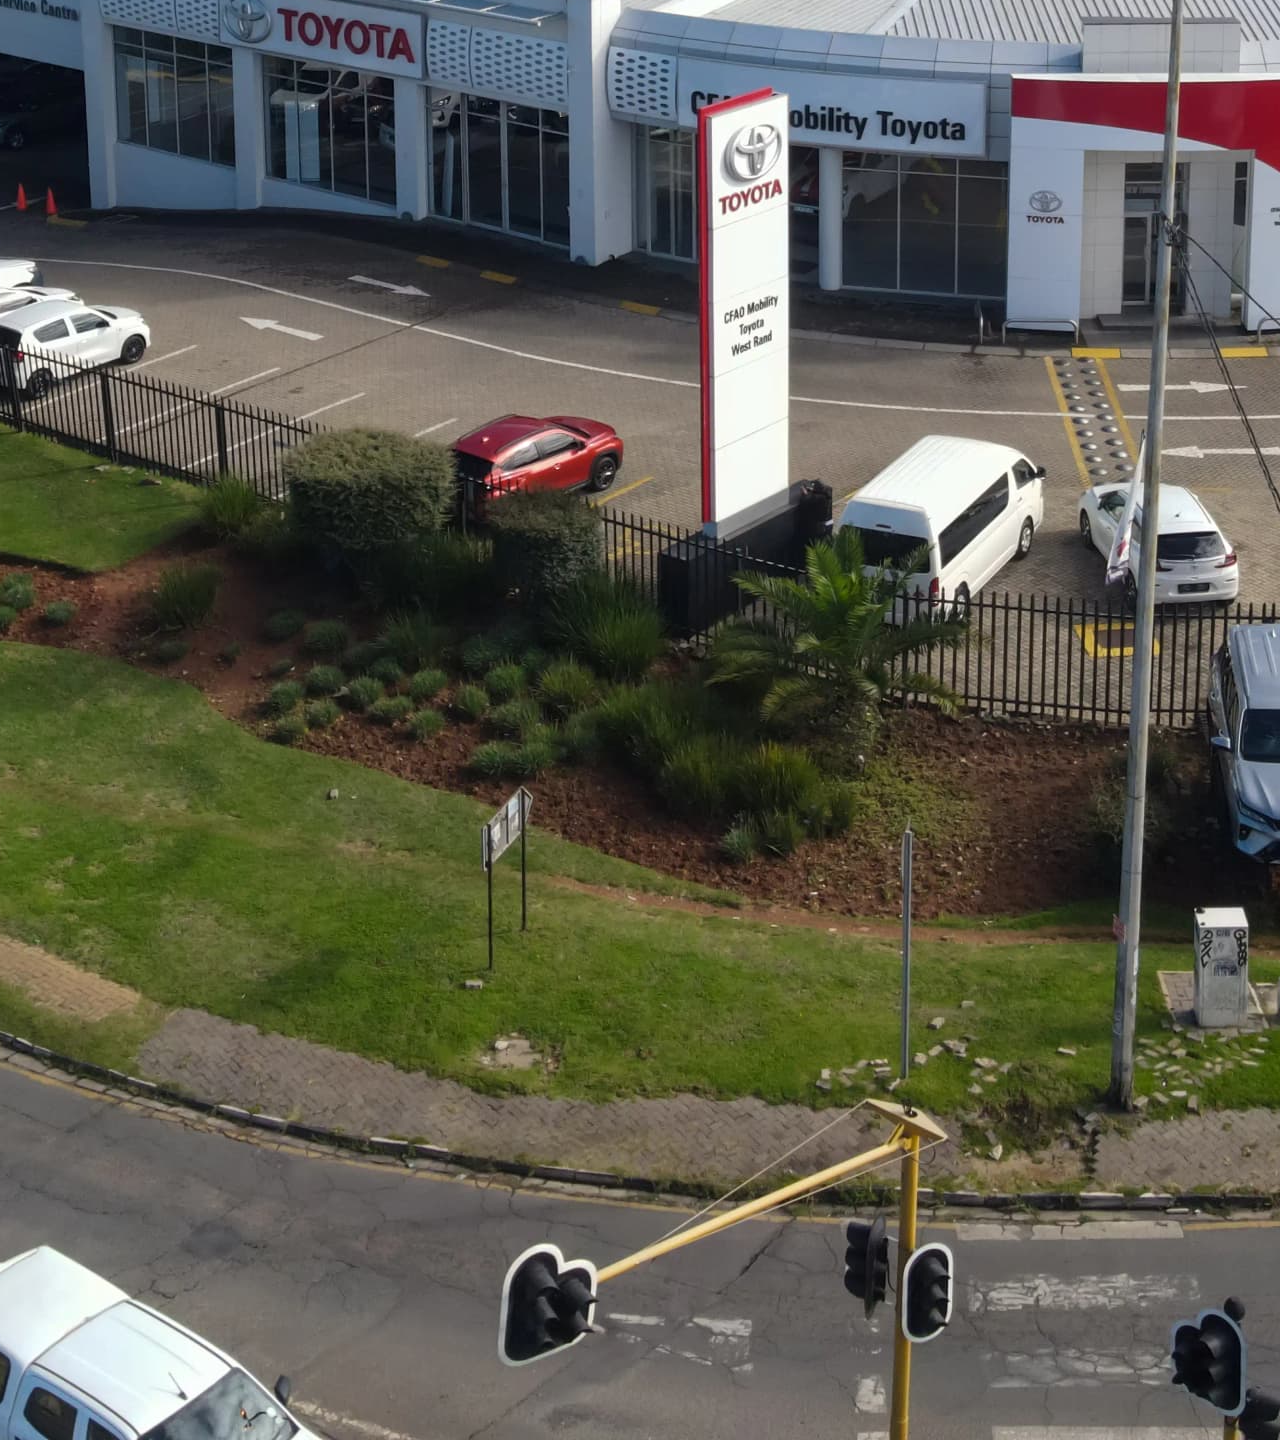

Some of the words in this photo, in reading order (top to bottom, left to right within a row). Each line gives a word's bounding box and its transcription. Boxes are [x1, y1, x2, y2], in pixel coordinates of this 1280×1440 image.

[277, 8, 415, 63] TOYOTA
[788, 104, 868, 141] obility
[876, 110, 966, 145] Toyota
[719, 178, 783, 216] TOYOTA
[1026, 215, 1065, 224] TOYOTA
[723, 305, 745, 325] CFAO
[746, 295, 779, 316] Mobility
[738, 318, 765, 336] Toyota
[730, 339, 752, 357] West
[752, 329, 773, 348] Rand
